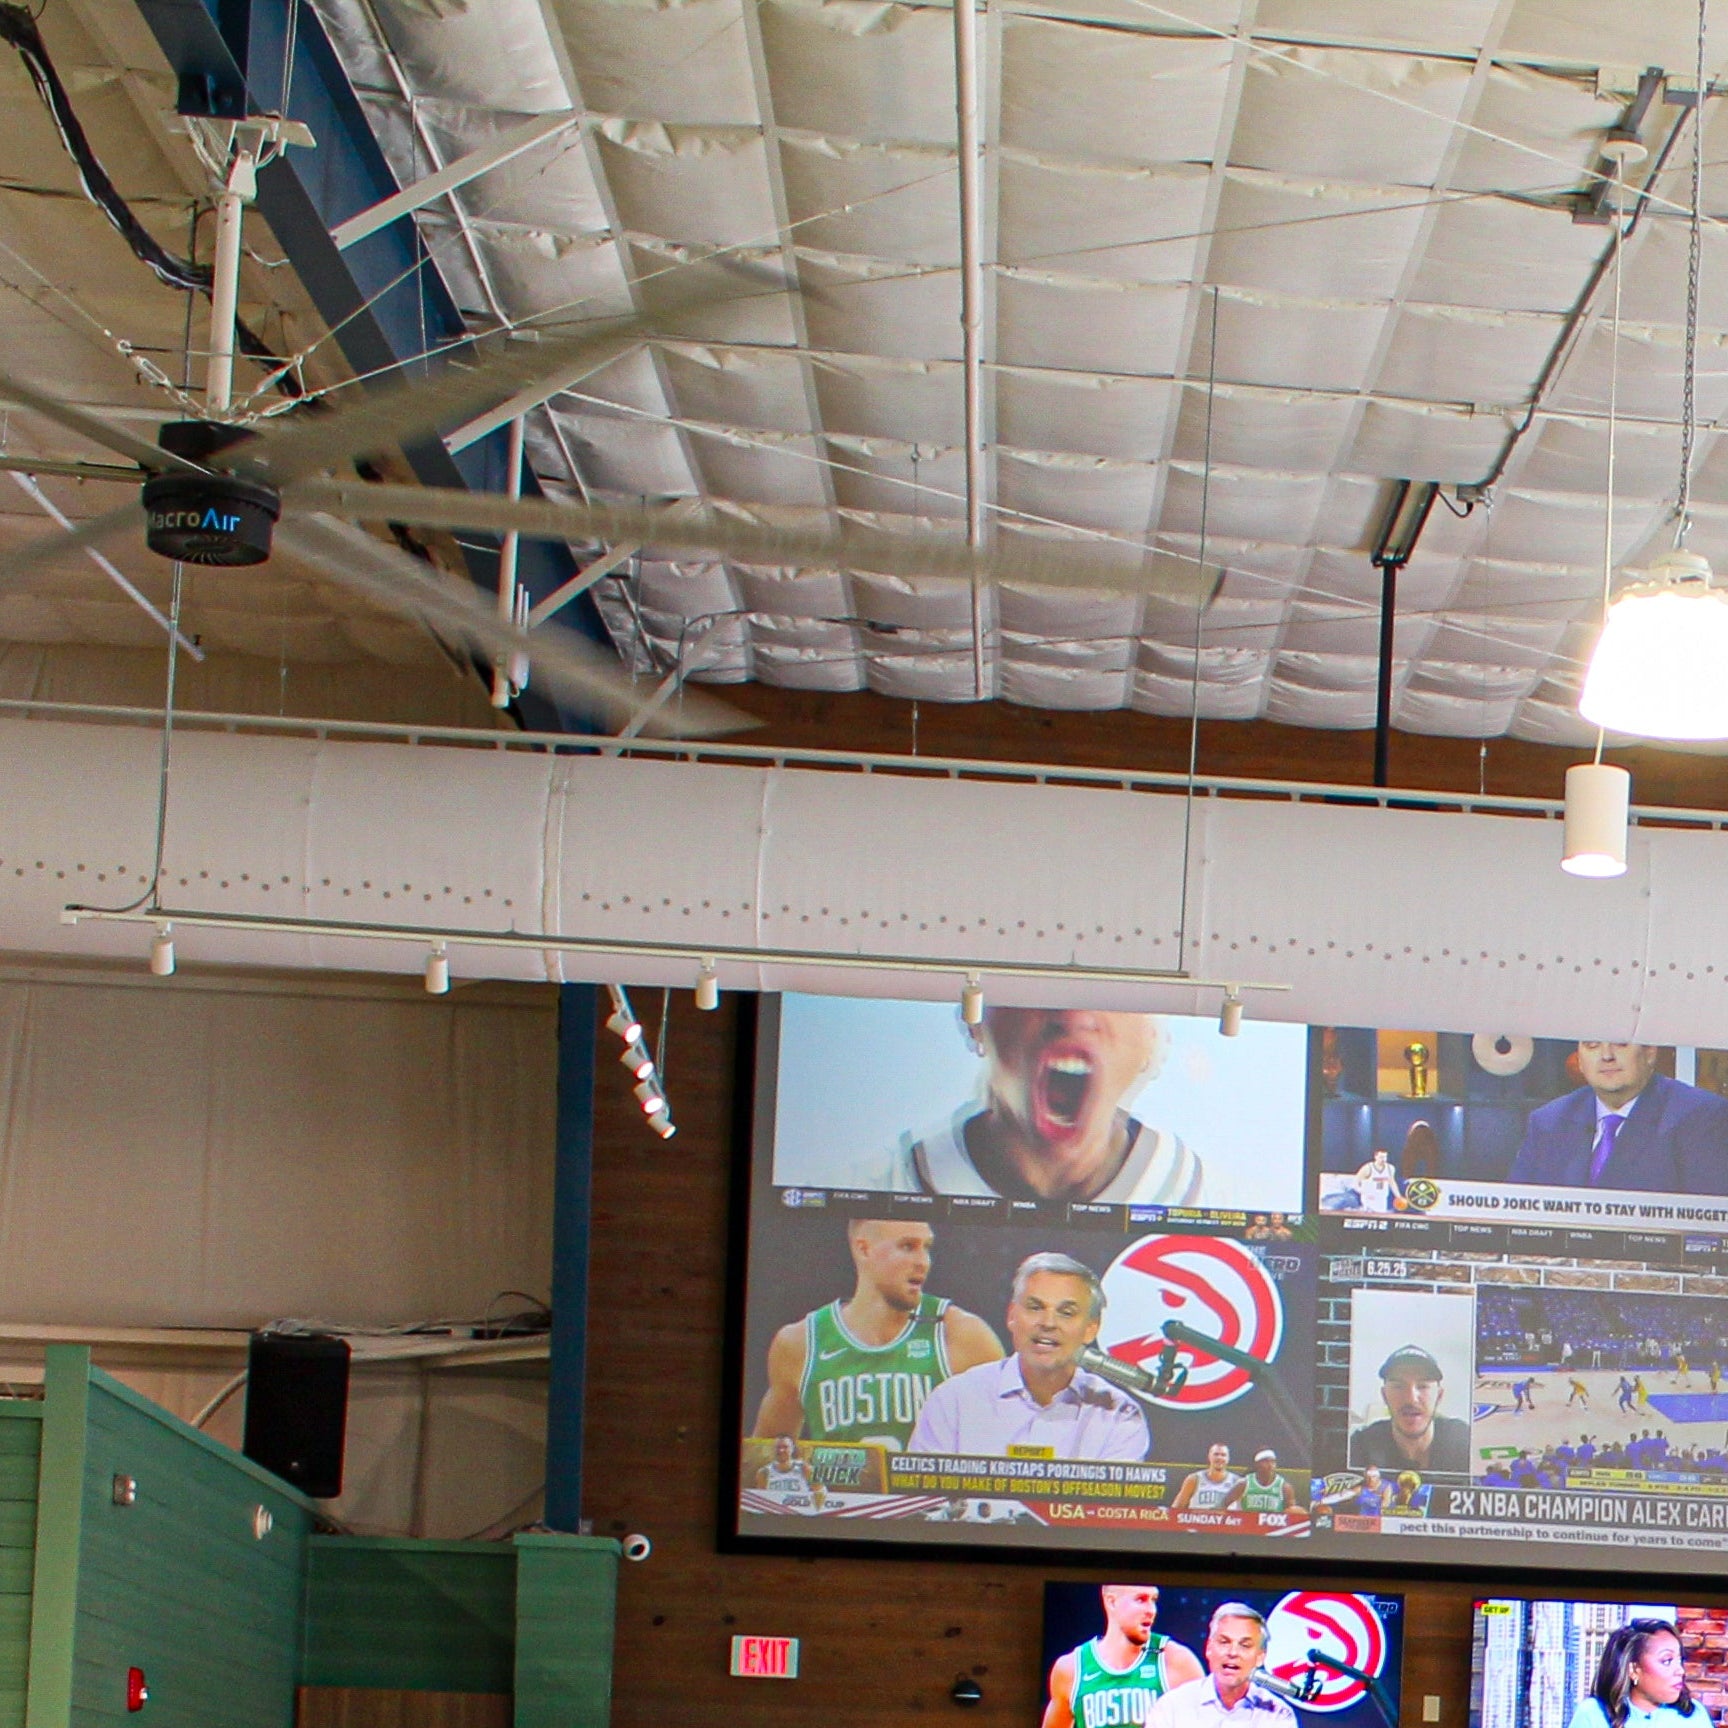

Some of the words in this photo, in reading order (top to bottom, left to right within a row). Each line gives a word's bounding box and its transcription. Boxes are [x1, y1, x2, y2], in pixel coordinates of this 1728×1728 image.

[151, 507, 240, 532] acroAir
[1448, 1194, 1500, 1209] SHOULD
[1502, 1197, 1540, 1211] JOKIC
[1543, 1199, 1581, 1213] WANT
[1585, 1202, 1602, 1214] TO
[1605, 1203, 1636, 1217] STAY
[1639, 1205, 1674, 1219] WITH
[1367, 1260, 1407, 1277] 6.25.25
[819, 1373, 932, 1432] BOSTON
[892, 1456, 935, 1472] CELTICS
[938, 1458, 986, 1474] TRADING
[989, 1460, 1044, 1478] KRISTAPS
[1047, 1463, 1106, 1480] PORZINGIS
[1109, 1467, 1123, 1481] TO
[1125, 1467, 1166, 1482] HAWKS
[962, 1477, 993, 1492] MAKE
[995, 1478, 1008, 1492] OF
[1010, 1478, 1060, 1494] BOSTON'S
[1062, 1480, 1121, 1497] OFFSEASON
[1049, 1503, 1085, 1519] USA
[1097, 1505, 1138, 1520] COSTA
[1140, 1507, 1169, 1521] RICA
[1177, 1512, 1223, 1525] SUNDAY
[1258, 1512, 1288, 1527] FOX
[1450, 1491, 1475, 1516] 2X
[1479, 1493, 1520, 1518] NBA
[1524, 1494, 1628, 1524] CHAMPION
[1632, 1500, 1681, 1526] ALEX
[1400, 1522, 1428, 1534] pect
[1431, 1522, 1455, 1534] this
[1458, 1525, 1533, 1541] partnership
[1536, 1528, 1549, 1539] to
[1552, 1529, 1608, 1543] continue
[1611, 1532, 1631, 1543] for
[1633, 1535, 1668, 1548] years
[1670, 1536, 1684, 1547] to
[744, 1638, 790, 1675] EXIT
